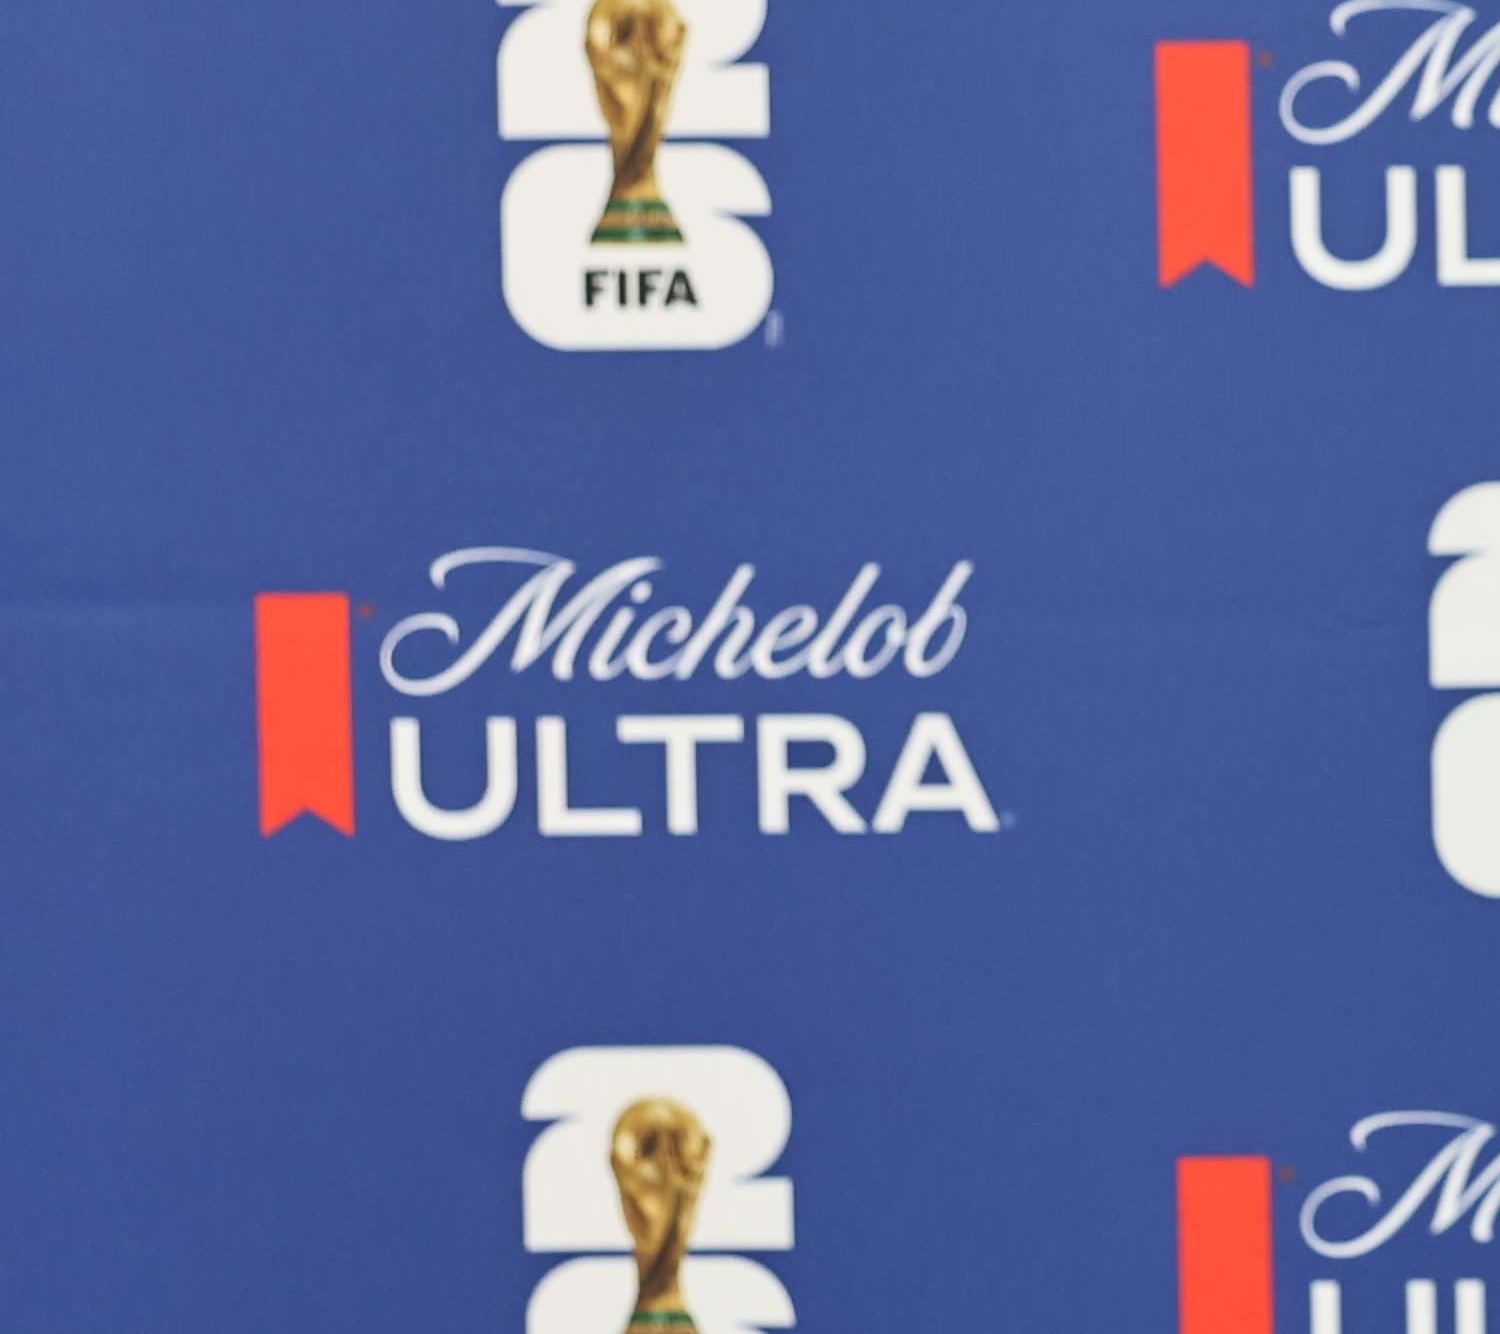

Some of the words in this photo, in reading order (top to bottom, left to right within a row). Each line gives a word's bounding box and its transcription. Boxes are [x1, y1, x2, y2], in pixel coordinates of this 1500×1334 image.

[585, 271, 696, 306] FIFA
[381, 548, 971, 695] Michelob
[391, 714, 998, 839] ULTRA
